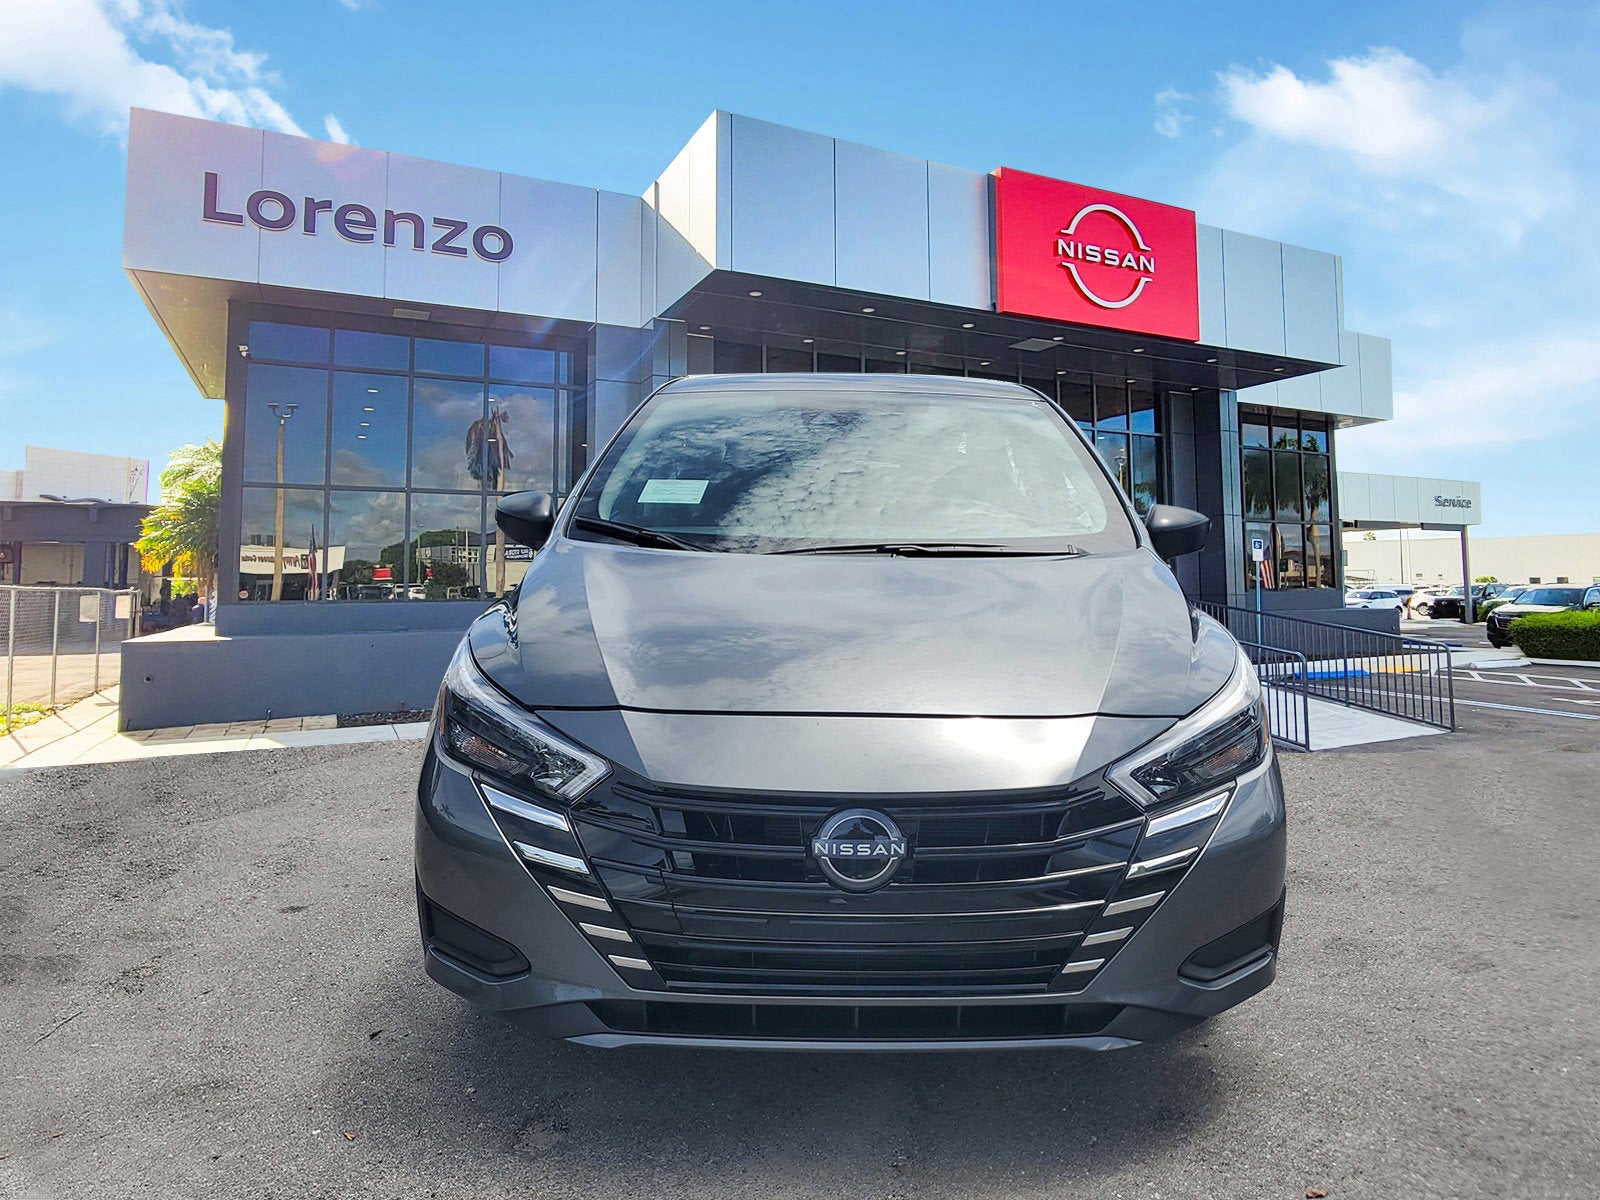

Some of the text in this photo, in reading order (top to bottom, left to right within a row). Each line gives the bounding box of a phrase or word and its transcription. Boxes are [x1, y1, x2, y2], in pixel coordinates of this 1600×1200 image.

[203, 171, 514, 262] Lorenzo
[1057, 238, 1155, 273] NISSAN
[1434, 495, 1472, 508] Service
[814, 842, 905, 856] NISSAN
